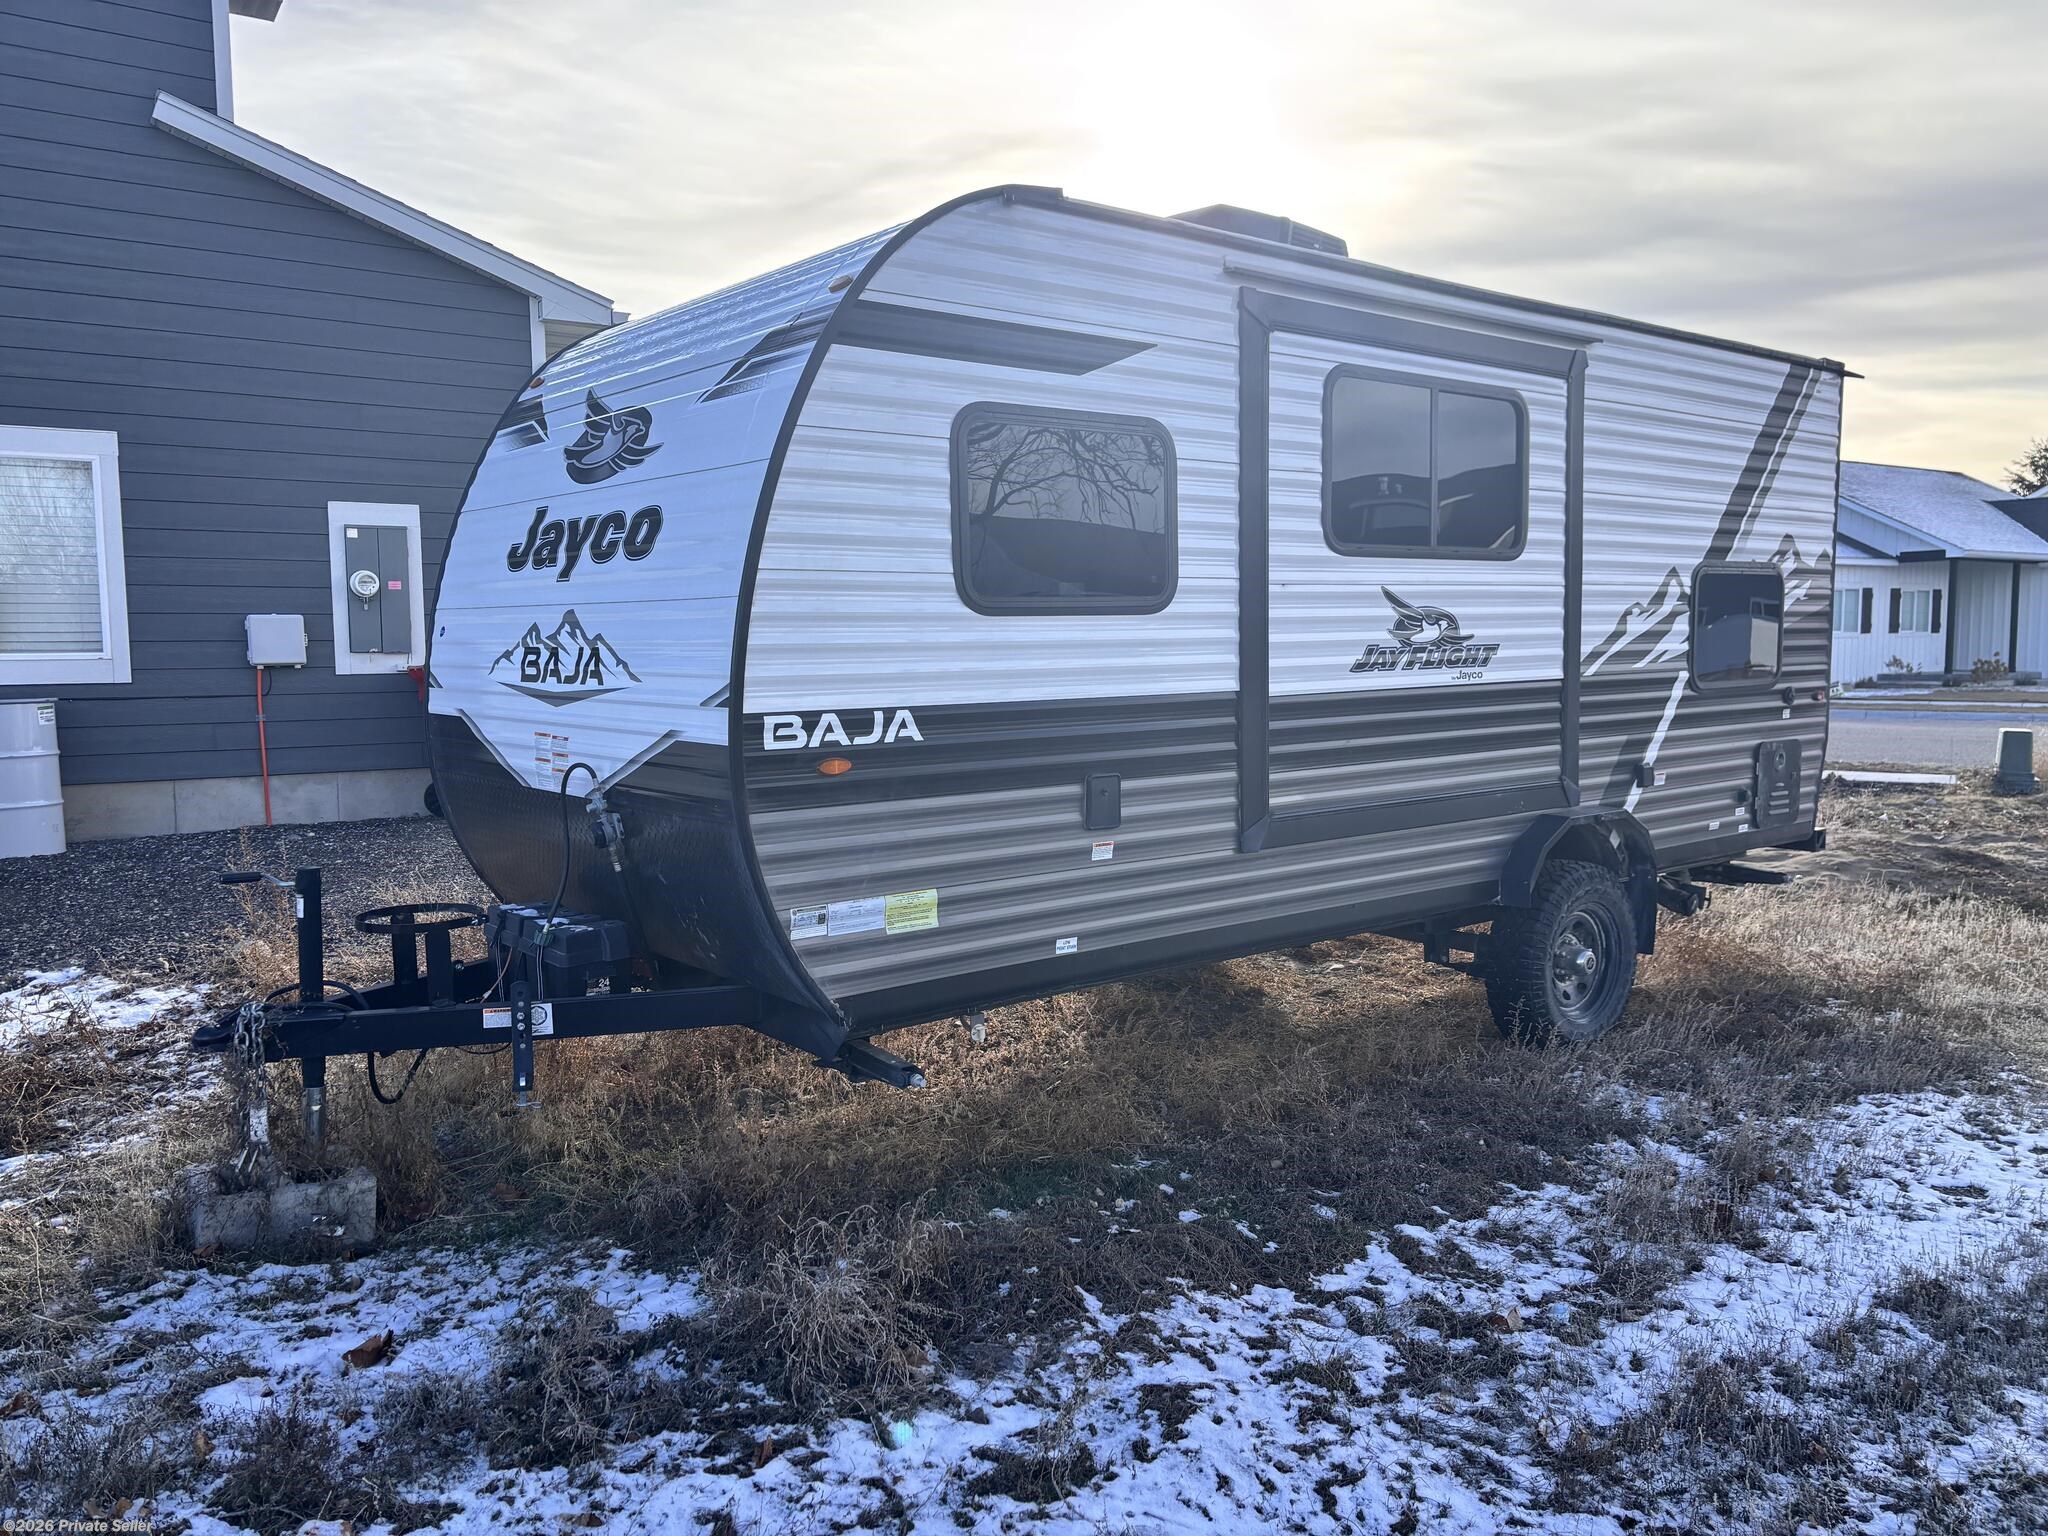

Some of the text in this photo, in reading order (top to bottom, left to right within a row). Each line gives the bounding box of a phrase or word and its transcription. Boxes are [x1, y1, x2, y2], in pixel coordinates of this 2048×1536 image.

[506, 504, 664, 583] Jayco
[520, 645, 605, 686] BAJA
[1349, 643, 1500, 672] JAY FLIGHT
[1456, 670, 1483, 681] Jayco
[763, 709, 924, 751] BAJA
[598, 977, 610, 987] 24
